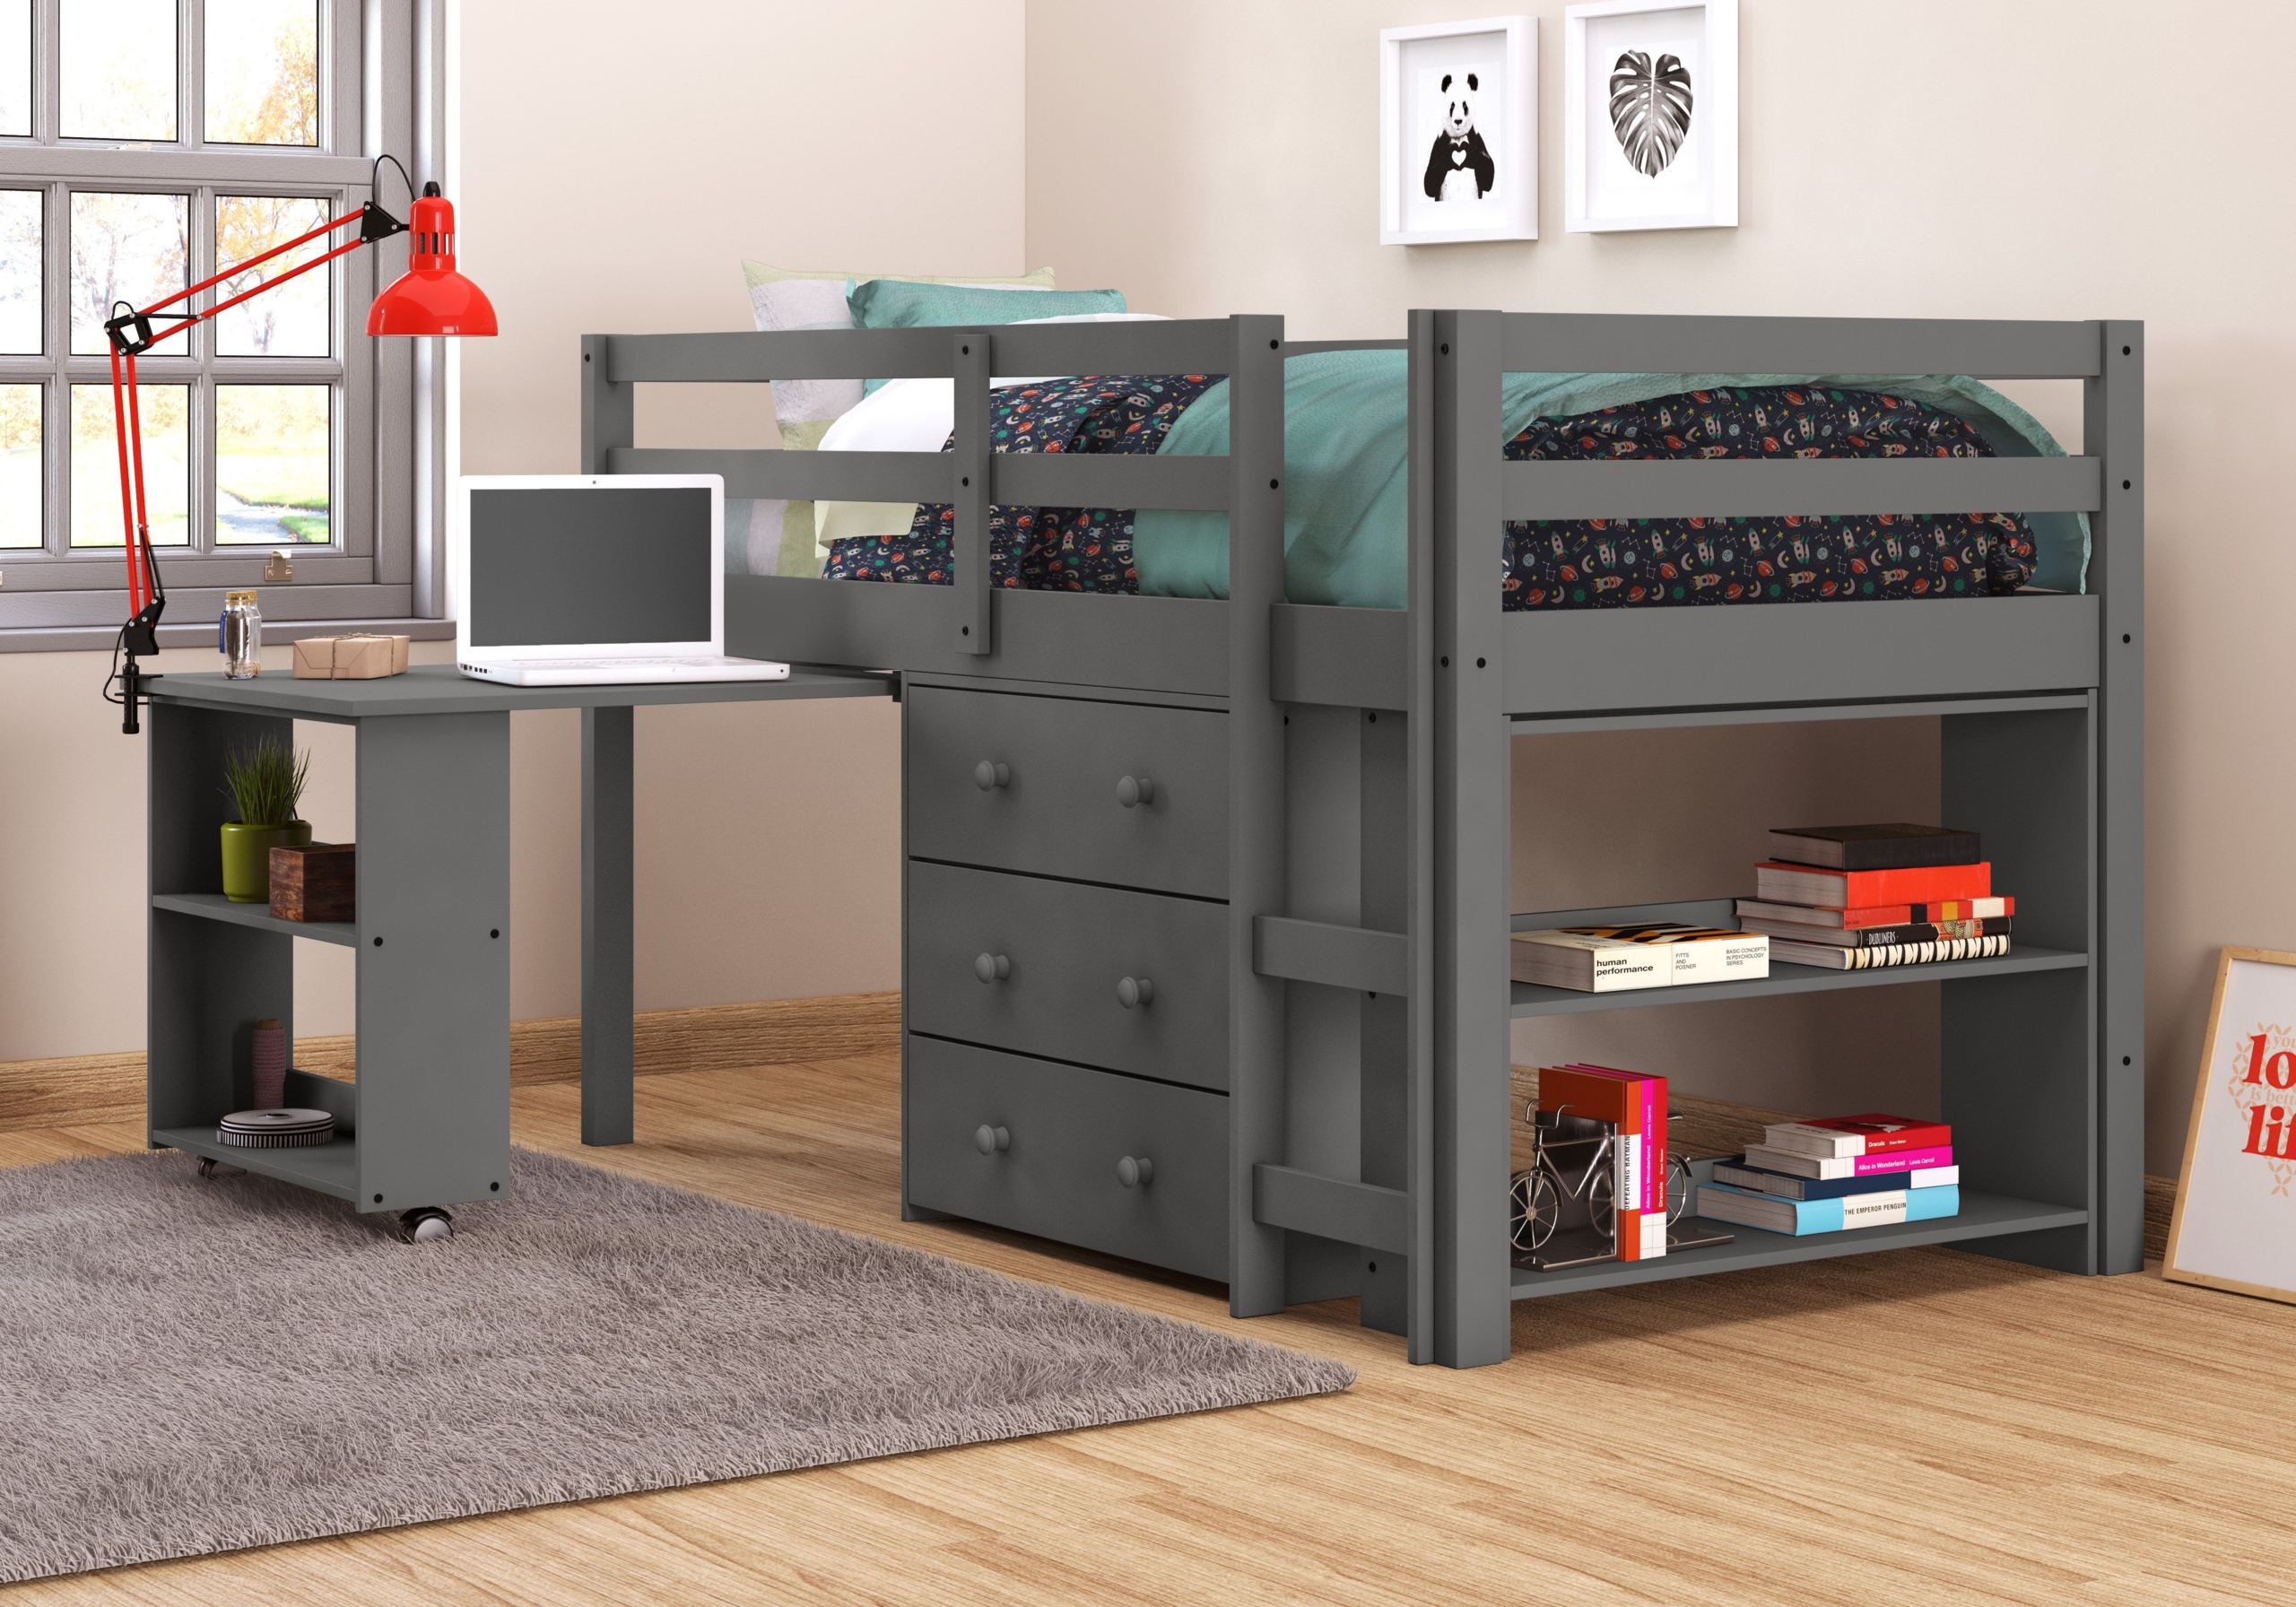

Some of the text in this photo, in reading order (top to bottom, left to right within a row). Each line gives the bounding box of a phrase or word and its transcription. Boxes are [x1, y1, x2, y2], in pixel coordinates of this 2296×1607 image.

[1868, 931, 1896, 945] DUBLINERS
[1732, 952, 1764, 960] PSYCHOLOGY
[1596, 965, 1654, 977] performance
[2250, 1086, 2262, 1101] is
[1876, 1160, 1906, 1168] Wonderland
[1856, 1204, 1882, 1214] EMPEROR
[1883, 1202, 1907, 1211] PENGUIN
